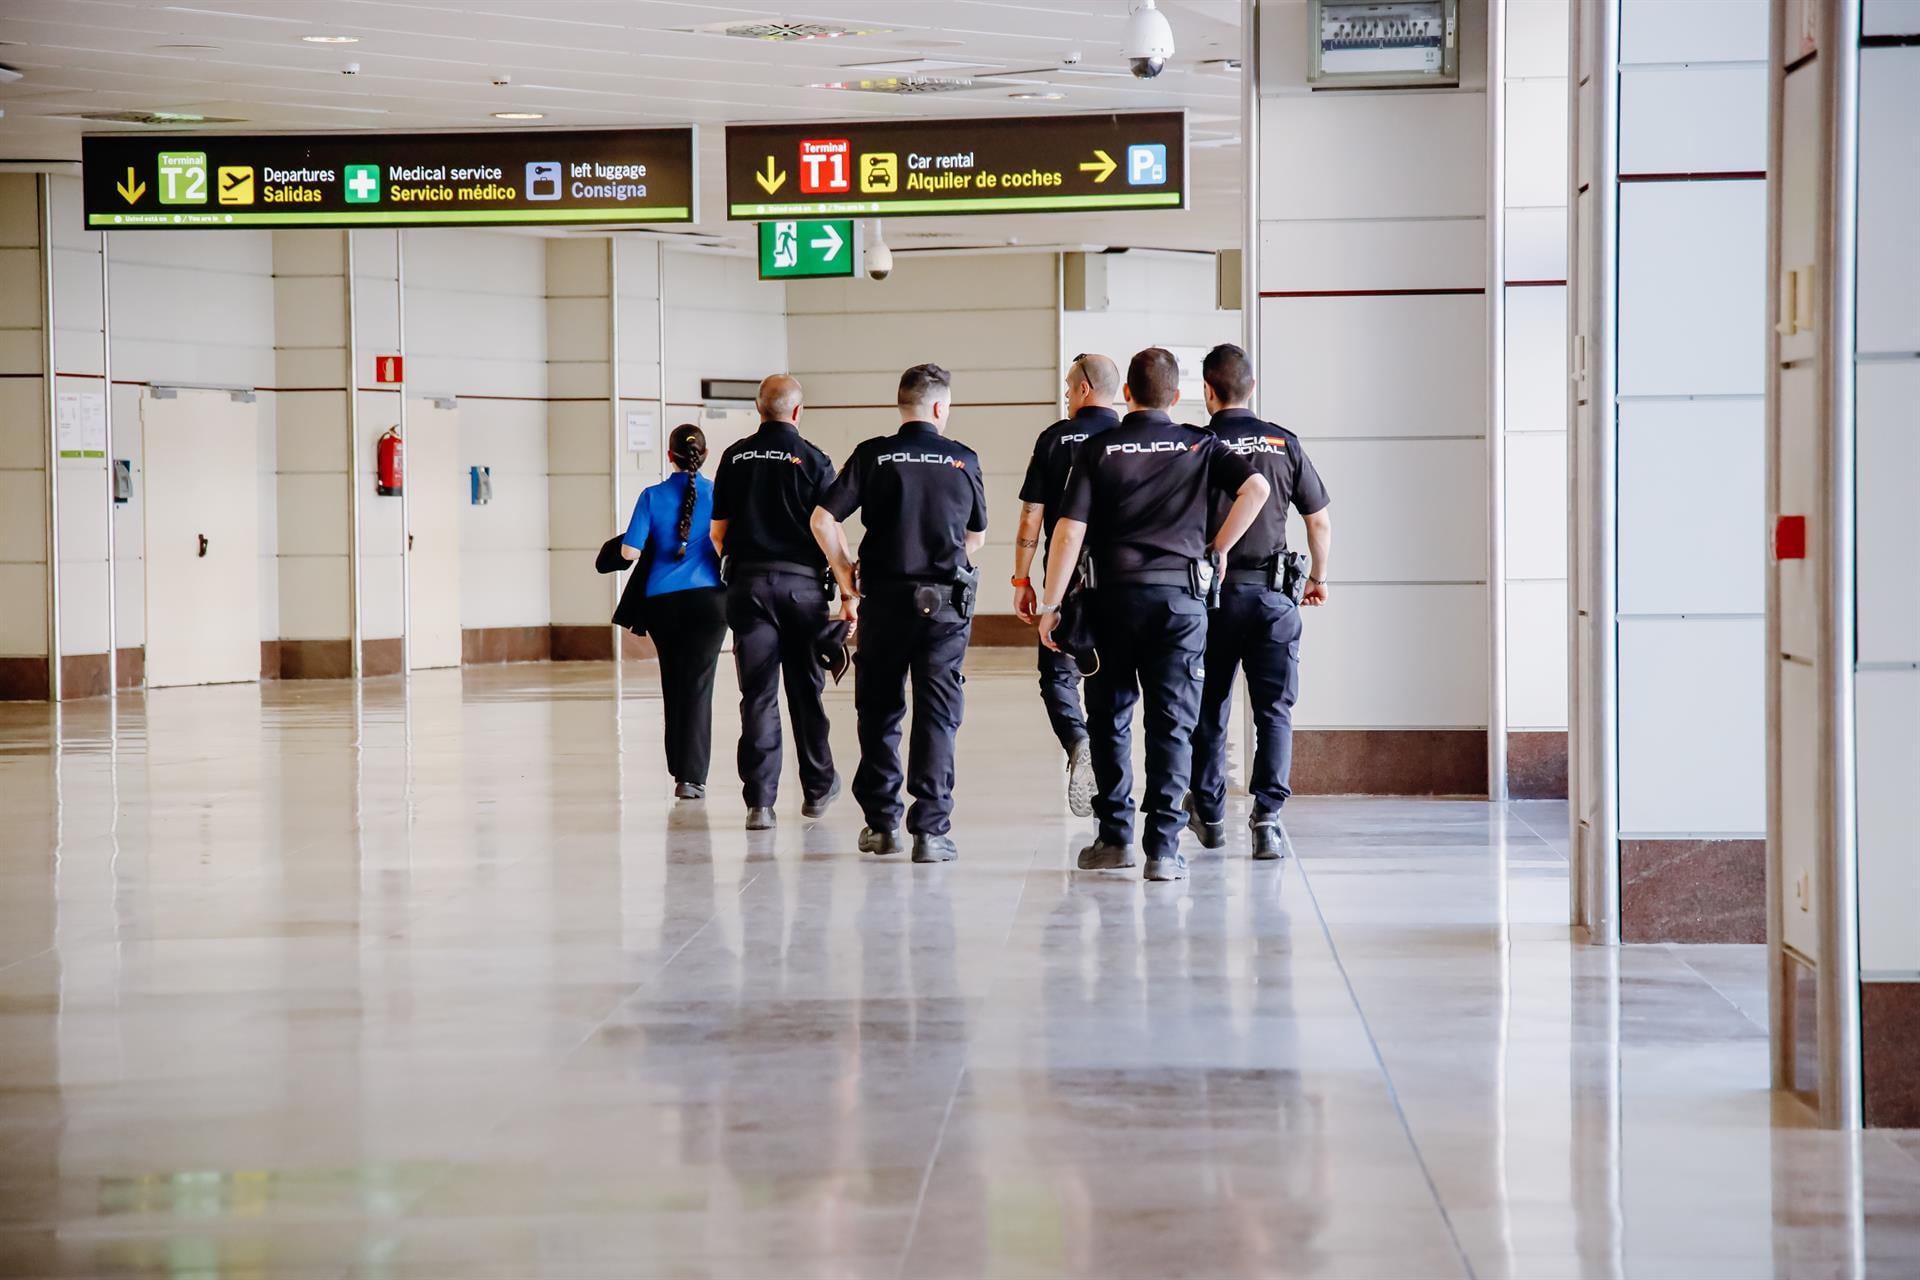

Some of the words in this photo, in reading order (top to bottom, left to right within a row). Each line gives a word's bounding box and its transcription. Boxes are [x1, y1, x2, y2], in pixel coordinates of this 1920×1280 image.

[803, 142, 847, 153] Terminal
[162, 156, 203, 165] Terminal
[908, 153, 932, 169] Car
[936, 152, 974, 168] rental
[263, 167, 335, 183] Departures
[389, 166, 446, 181] Medical
[450, 166, 502, 181] service
[570, 163, 591, 178] left
[595, 162, 646, 180] luggage
[802, 154, 847, 188] T1
[160, 167, 206, 199] T2
[907, 173, 971, 193] Alquiler
[976, 171, 997, 188] de
[1002, 170, 1062, 187] coches
[263, 185, 322, 202] Salidas
[390, 186, 453, 201] Servicio
[458, 185, 516, 201] médico
[571, 181, 647, 200] Consigna
[1106, 441, 1188, 455] POLICIA
[732, 450, 792, 464] POLICIA
[877, 453, 956, 465] POLICIA
